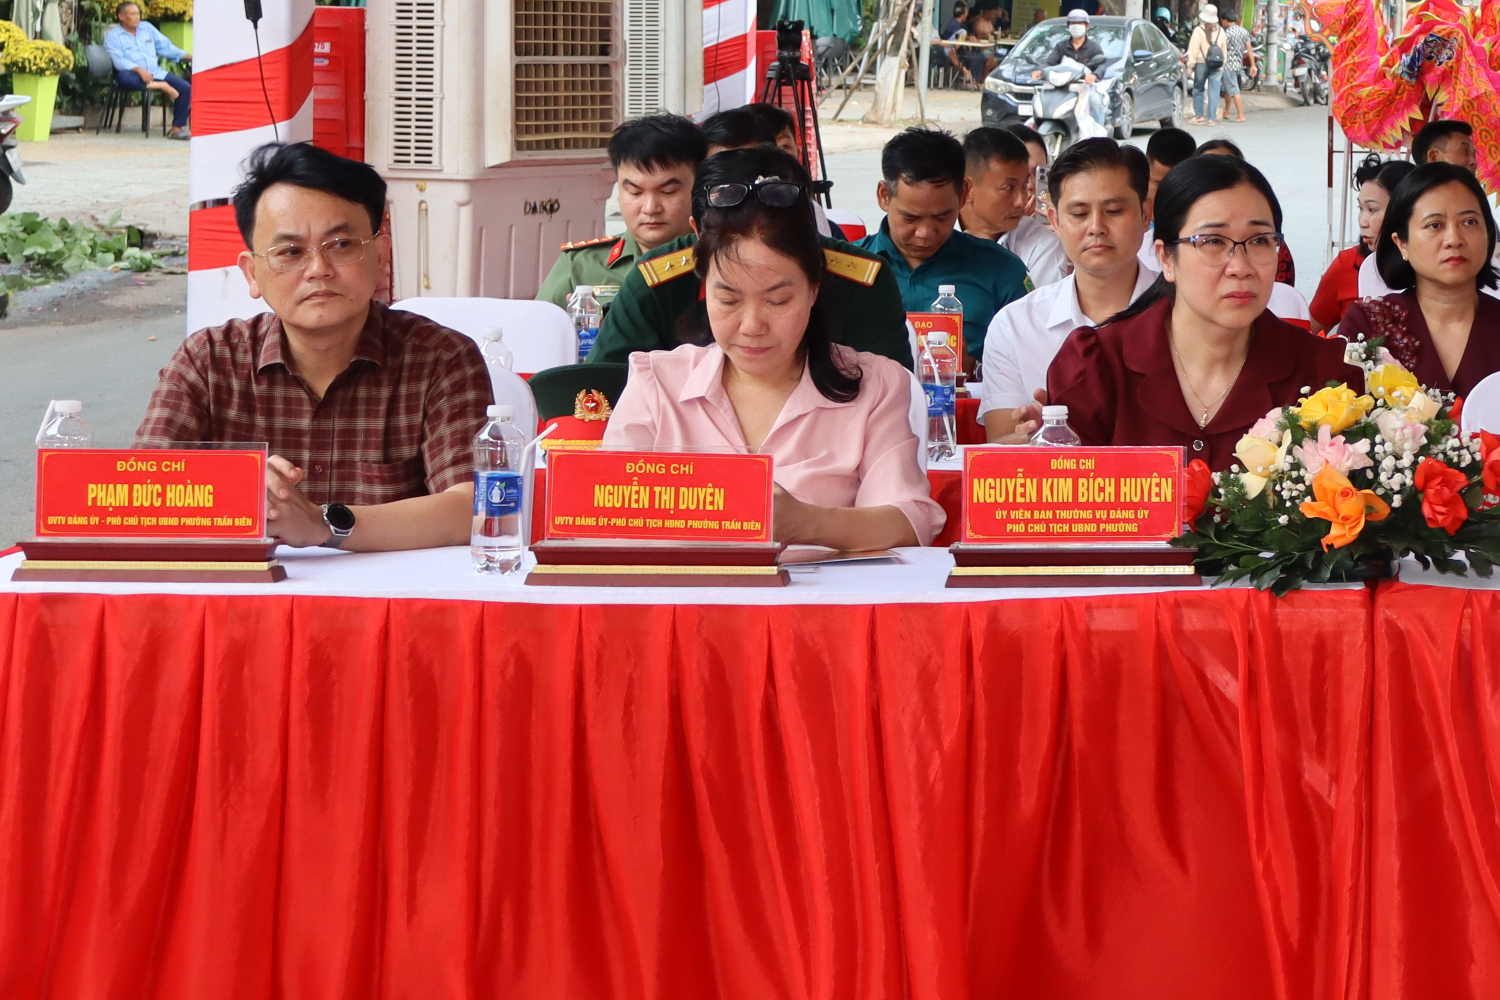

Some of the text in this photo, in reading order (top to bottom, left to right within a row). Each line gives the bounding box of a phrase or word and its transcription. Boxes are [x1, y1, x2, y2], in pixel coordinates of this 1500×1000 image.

[914, 321, 933, 330] ĐẠO
[116, 456, 186, 472] ĐỒNG CHÍ
[625, 458, 694, 475] ĐỒNG CHÍ
[1050, 454, 1096, 470] ĐỒNG CHÍ
[972, 467, 1174, 504] NGUYỄN KIM BÍCH HUYÊN
[87, 478, 214, 512] PHẠM ĐỨC HOÀNG
[593, 476, 725, 515] NGUYỄN THỊ DUYÊN
[47, 515, 67, 525] UVTV
[106, 516, 122, 526] PHÓ
[139, 516, 157, 527] TỊCH
[158, 516, 180, 526] UBND
[180, 515, 212, 527] PHƯỜNG
[212, 514, 234, 527] TRẤN
[234, 515, 253, 527] BIÊN
[1009, 508, 1032, 520] VIÊN
[1033, 509, 1053, 520] BAN
[1054, 507, 1093, 520] THƯỜNG
[1094, 509, 1108, 521] VỤ
[554, 516, 574, 526] UVTV
[645, 518, 663, 529] TỊCH
[686, 518, 720, 530] PHƯỜNG
[721, 518, 742, 530] TRẤN
[742, 519, 762, 531] BIÊN
[1006, 521, 1026, 533] PHÓ
[1048, 523, 1070, 535] TỊCH
[1071, 522, 1098, 533] UBND
[1099, 521, 1139, 533] PHƯỜNG
